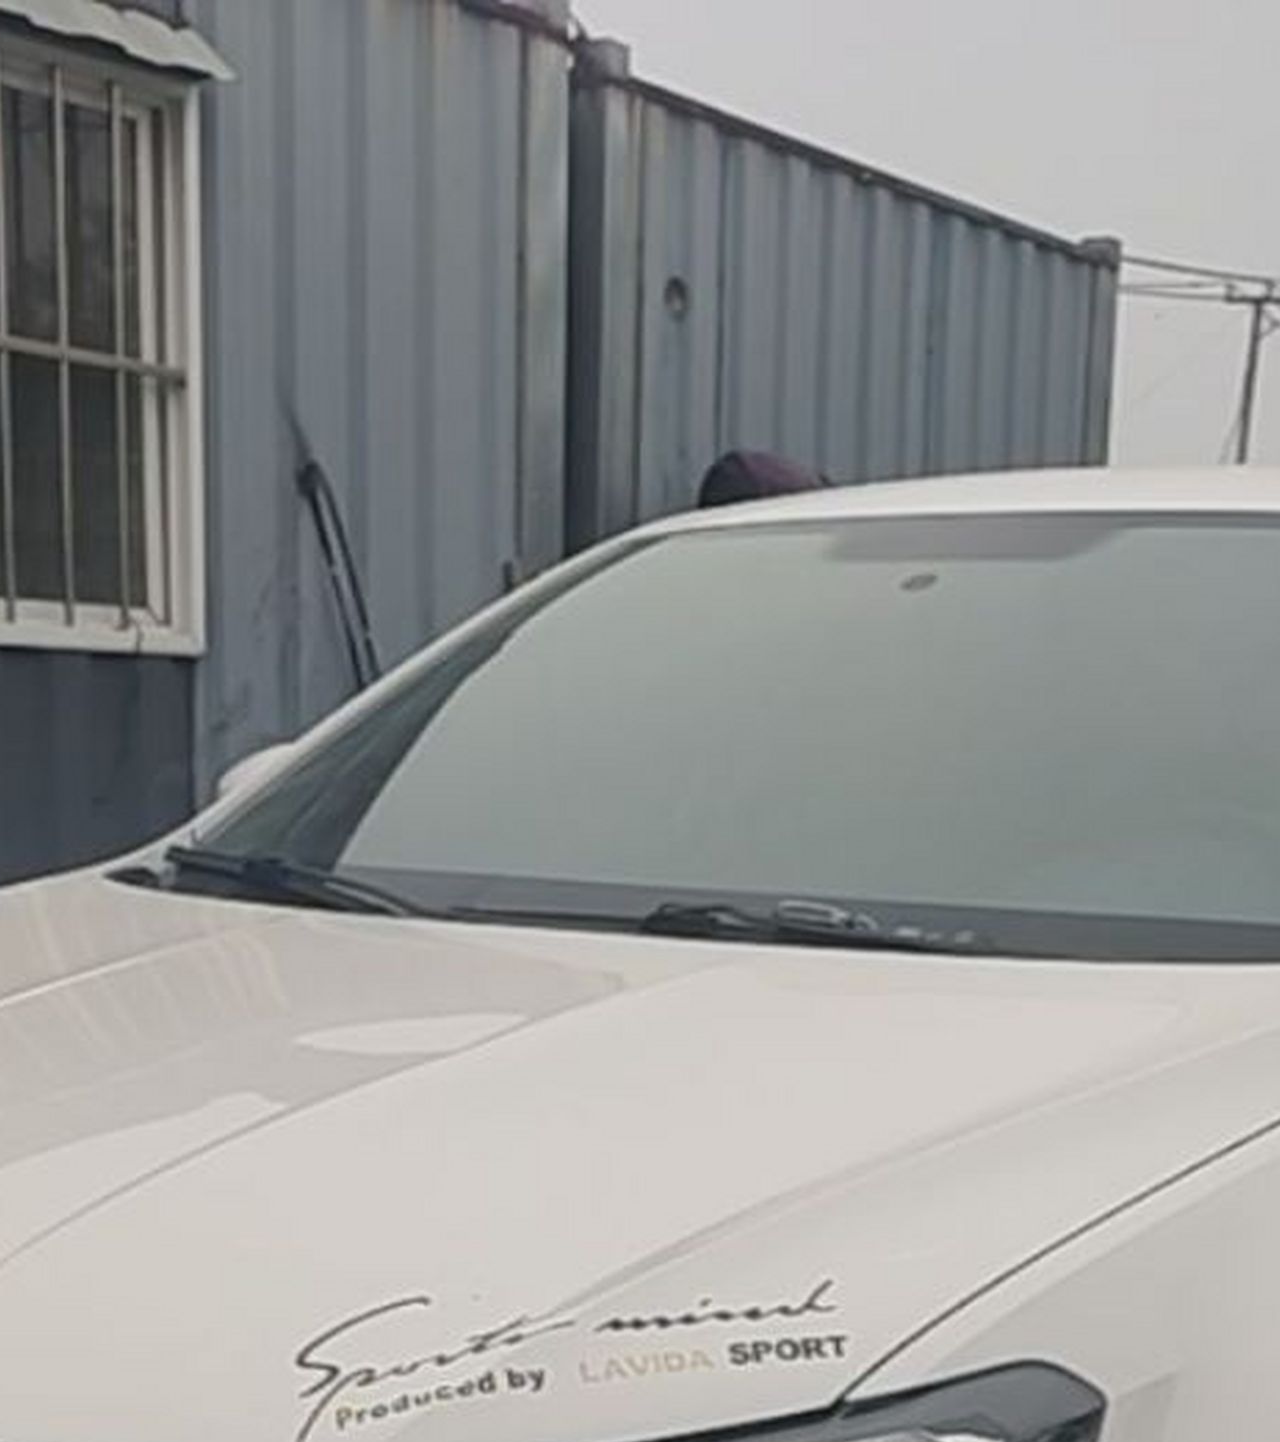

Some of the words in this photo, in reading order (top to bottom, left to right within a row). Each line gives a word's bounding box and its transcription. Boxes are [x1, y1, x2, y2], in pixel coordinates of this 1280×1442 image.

[335, 1371, 497, 1430] Produced
[506, 1368, 547, 1392] by
[579, 1350, 715, 1383] LAVIDA
[728, 1335, 847, 1366] SPORT
